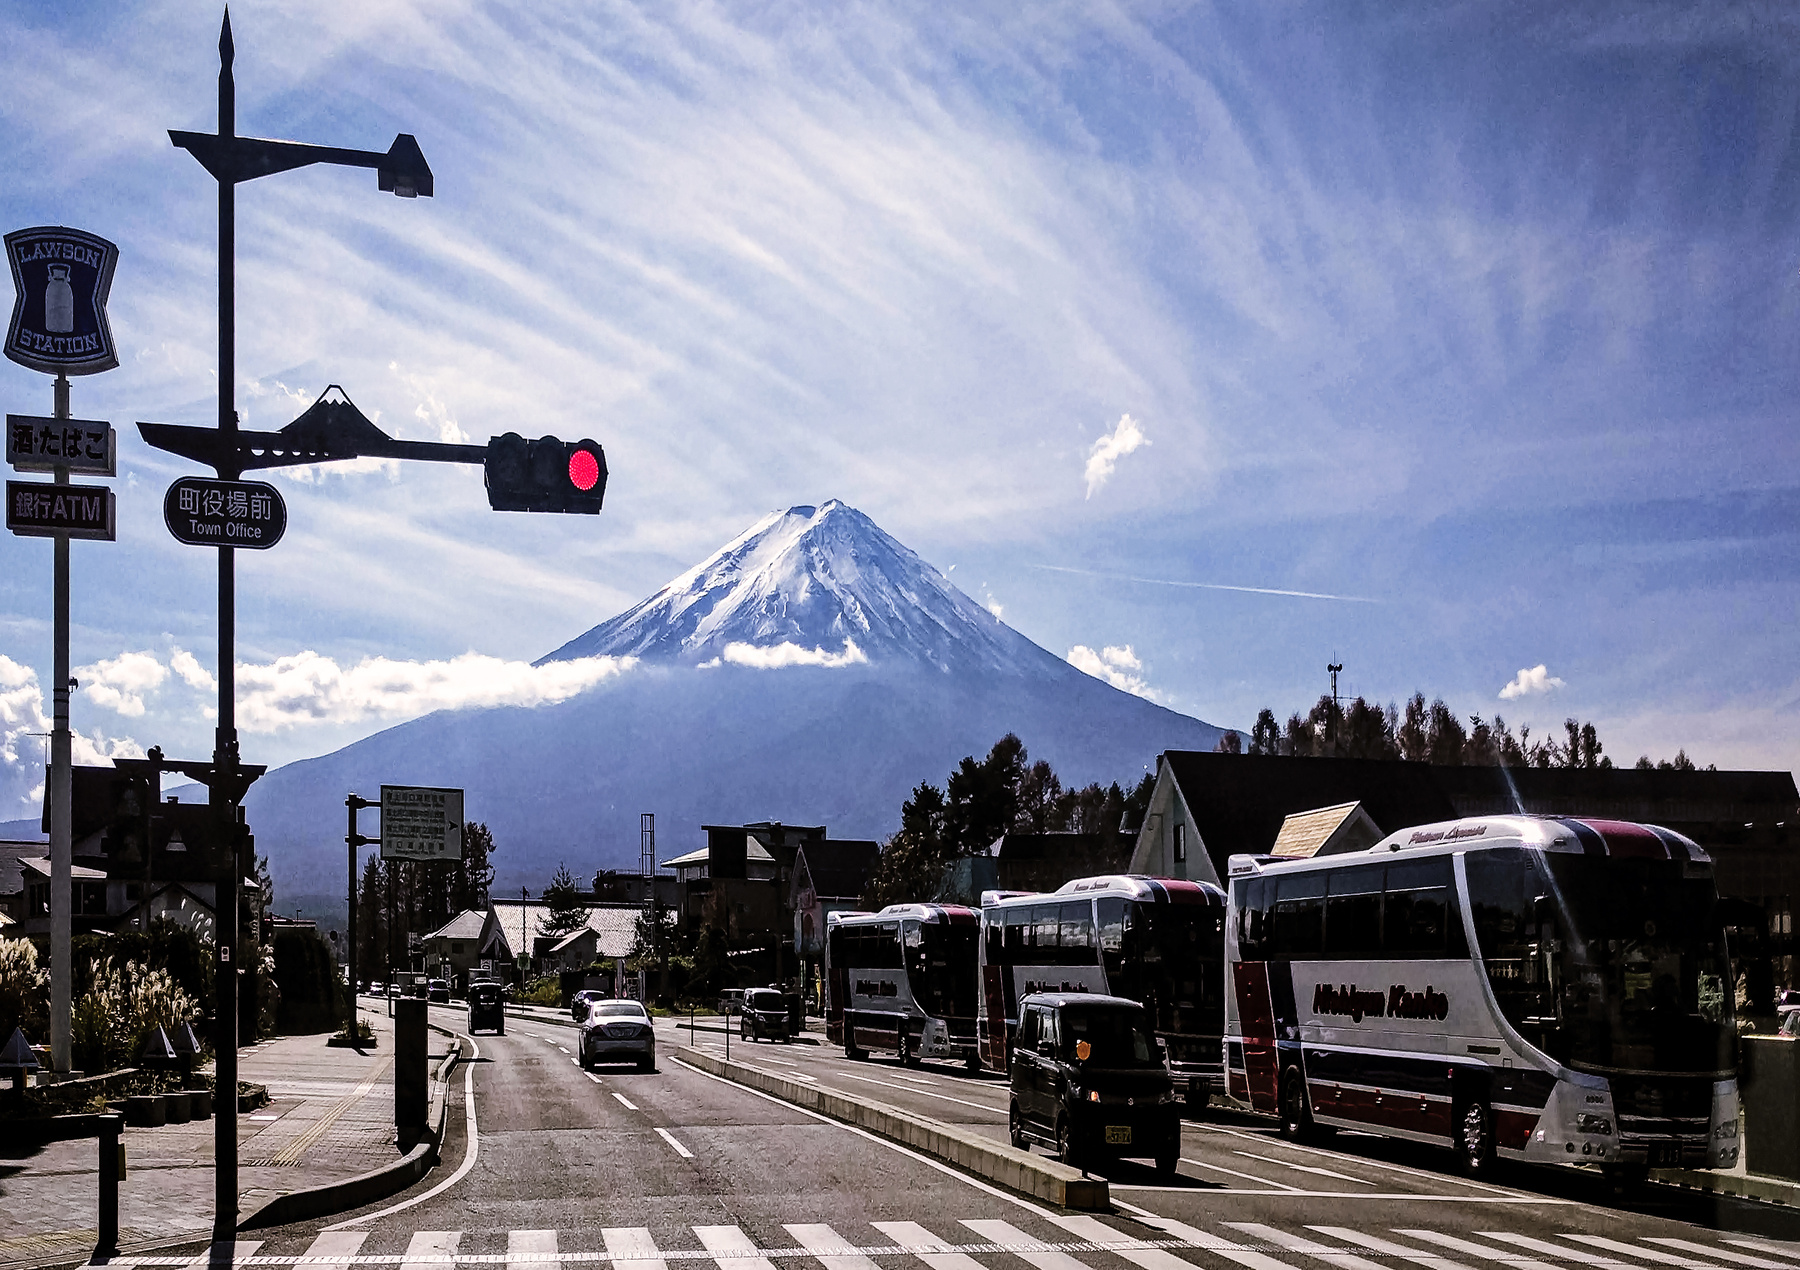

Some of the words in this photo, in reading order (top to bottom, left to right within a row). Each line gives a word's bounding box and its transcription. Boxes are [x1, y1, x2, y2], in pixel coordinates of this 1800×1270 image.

[18, 242, 100, 269] LAWSON
[19, 328, 99, 353] STATION
[15, 491, 100, 521] 銀行ATM
[180, 487, 272, 520] 町役場前
[189, 519, 221, 536] Town
[226, 521, 262, 539] Office
[1386, 984, 1449, 1022] Kanko
